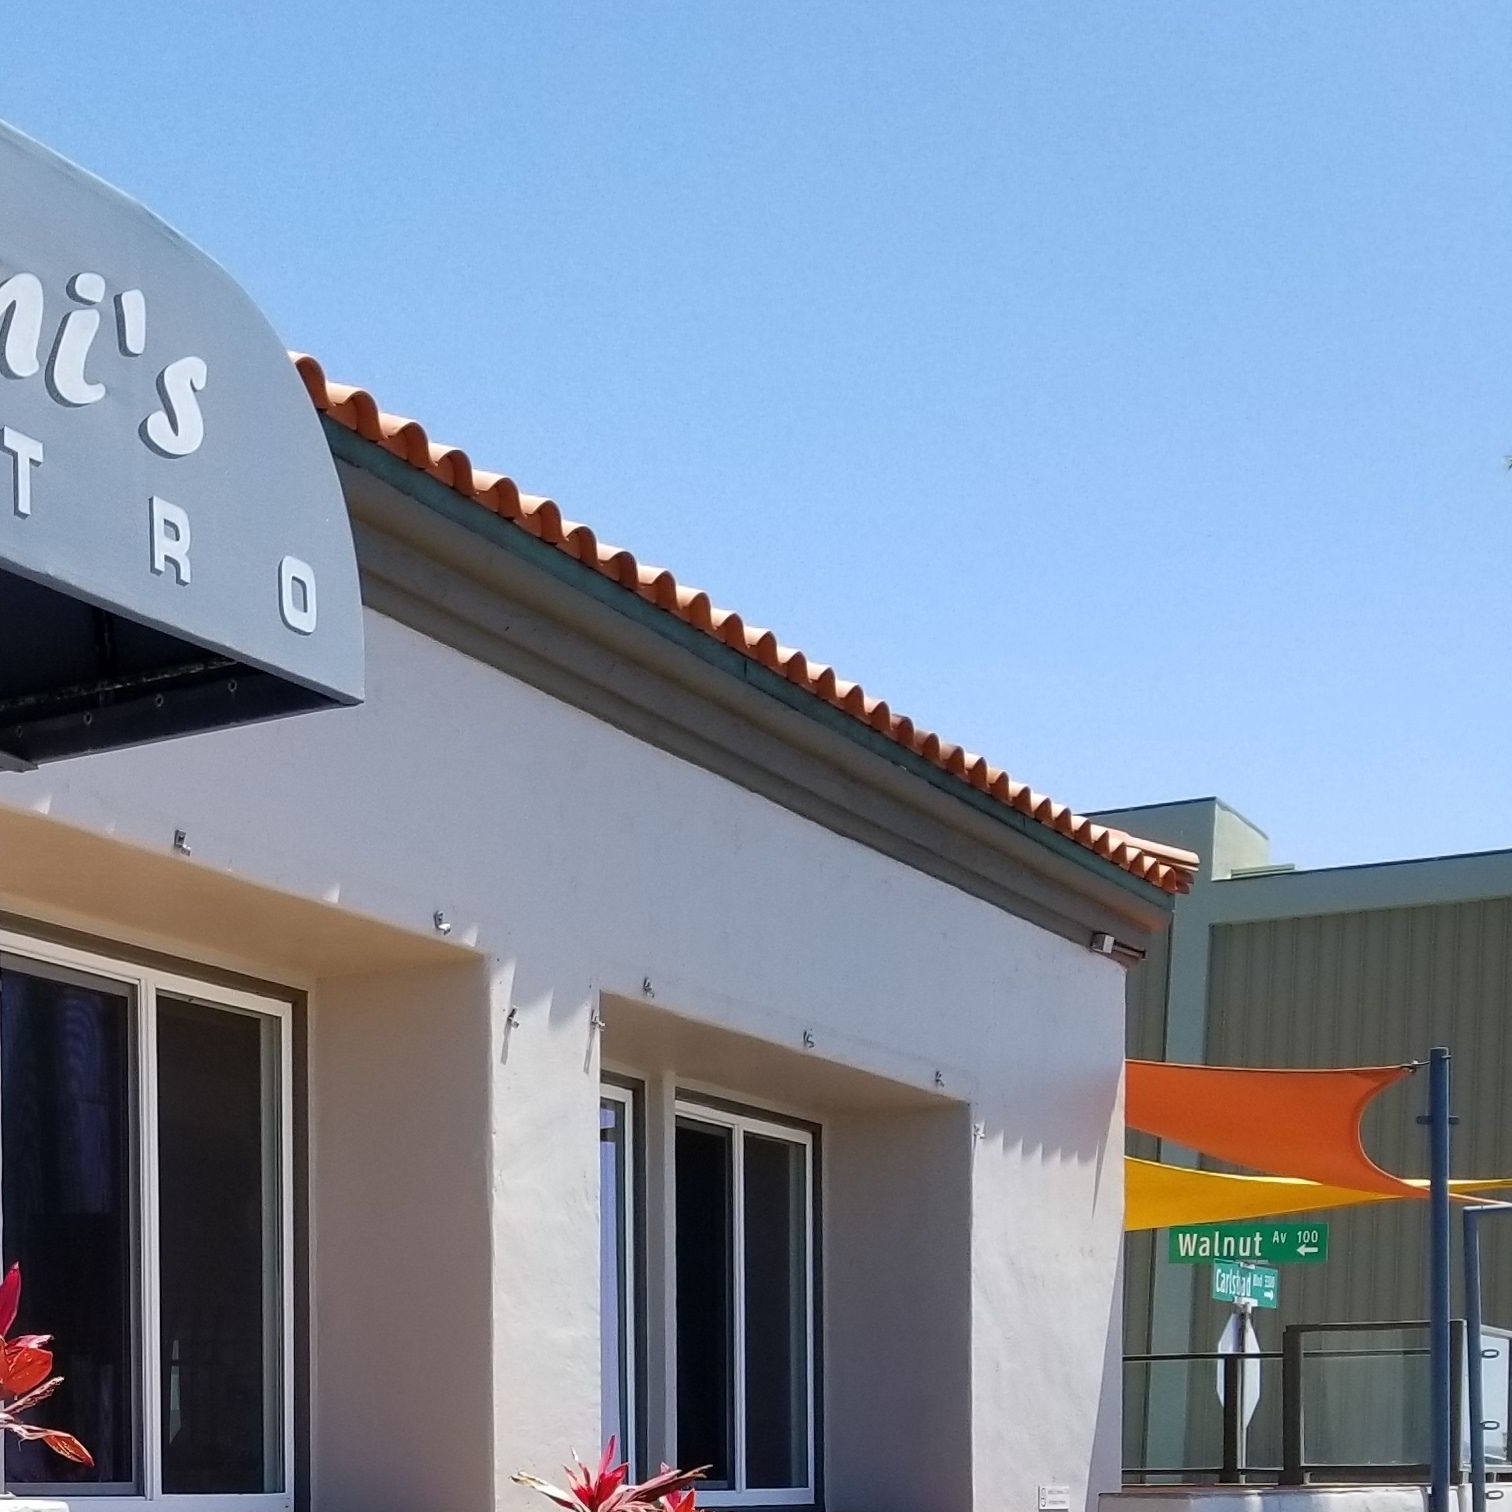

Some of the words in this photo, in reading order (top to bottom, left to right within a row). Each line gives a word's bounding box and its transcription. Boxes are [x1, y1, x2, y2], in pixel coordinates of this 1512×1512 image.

[1178, 1231, 1262, 1257] Walnut
[1272, 1230, 1287, 1244] Av
[1297, 1230, 1319, 1243] 100
[1216, 1268, 1251, 1297] Carlsbad
